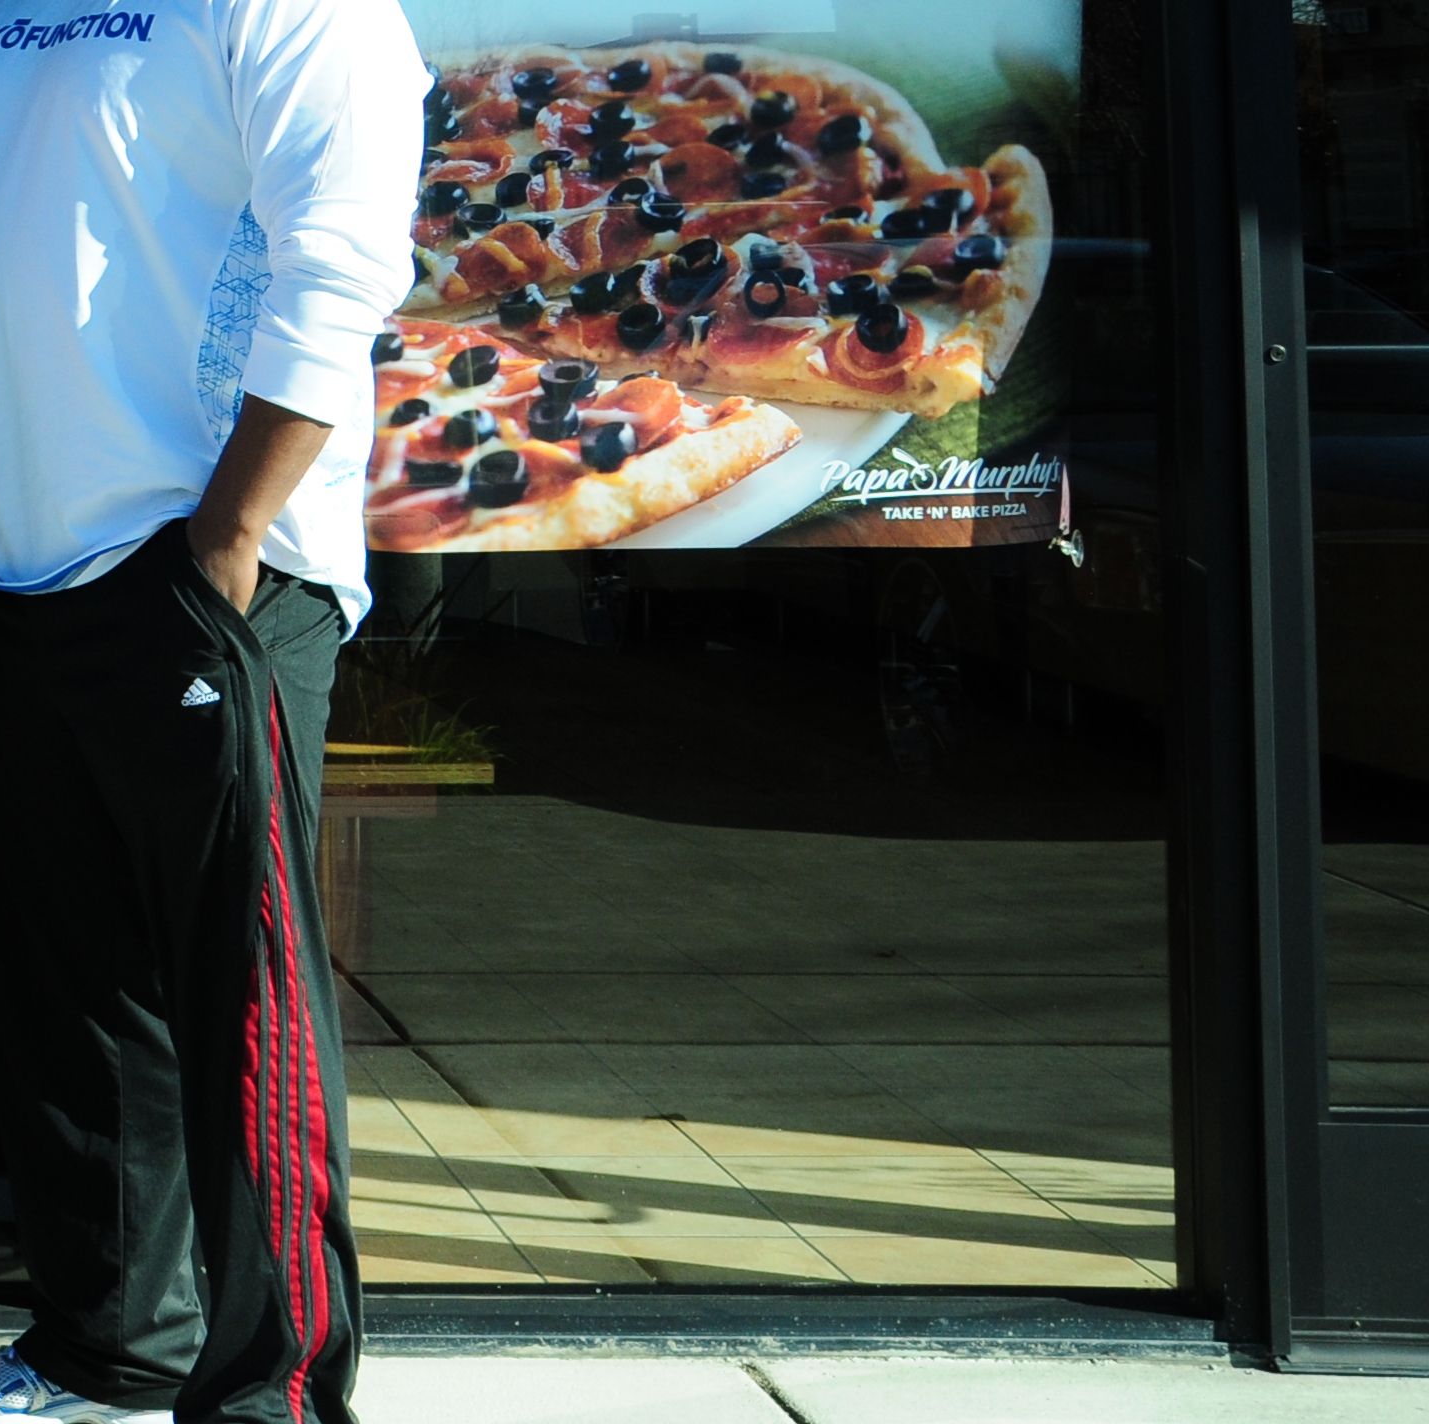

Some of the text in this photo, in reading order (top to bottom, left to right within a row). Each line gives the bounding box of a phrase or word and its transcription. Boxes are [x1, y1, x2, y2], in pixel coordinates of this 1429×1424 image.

[820, 459, 909, 505] Papa
[882, 506, 924, 520] TAKE
[951, 505, 989, 519] BAKE
[991, 503, 1027, 516] PIZZA
